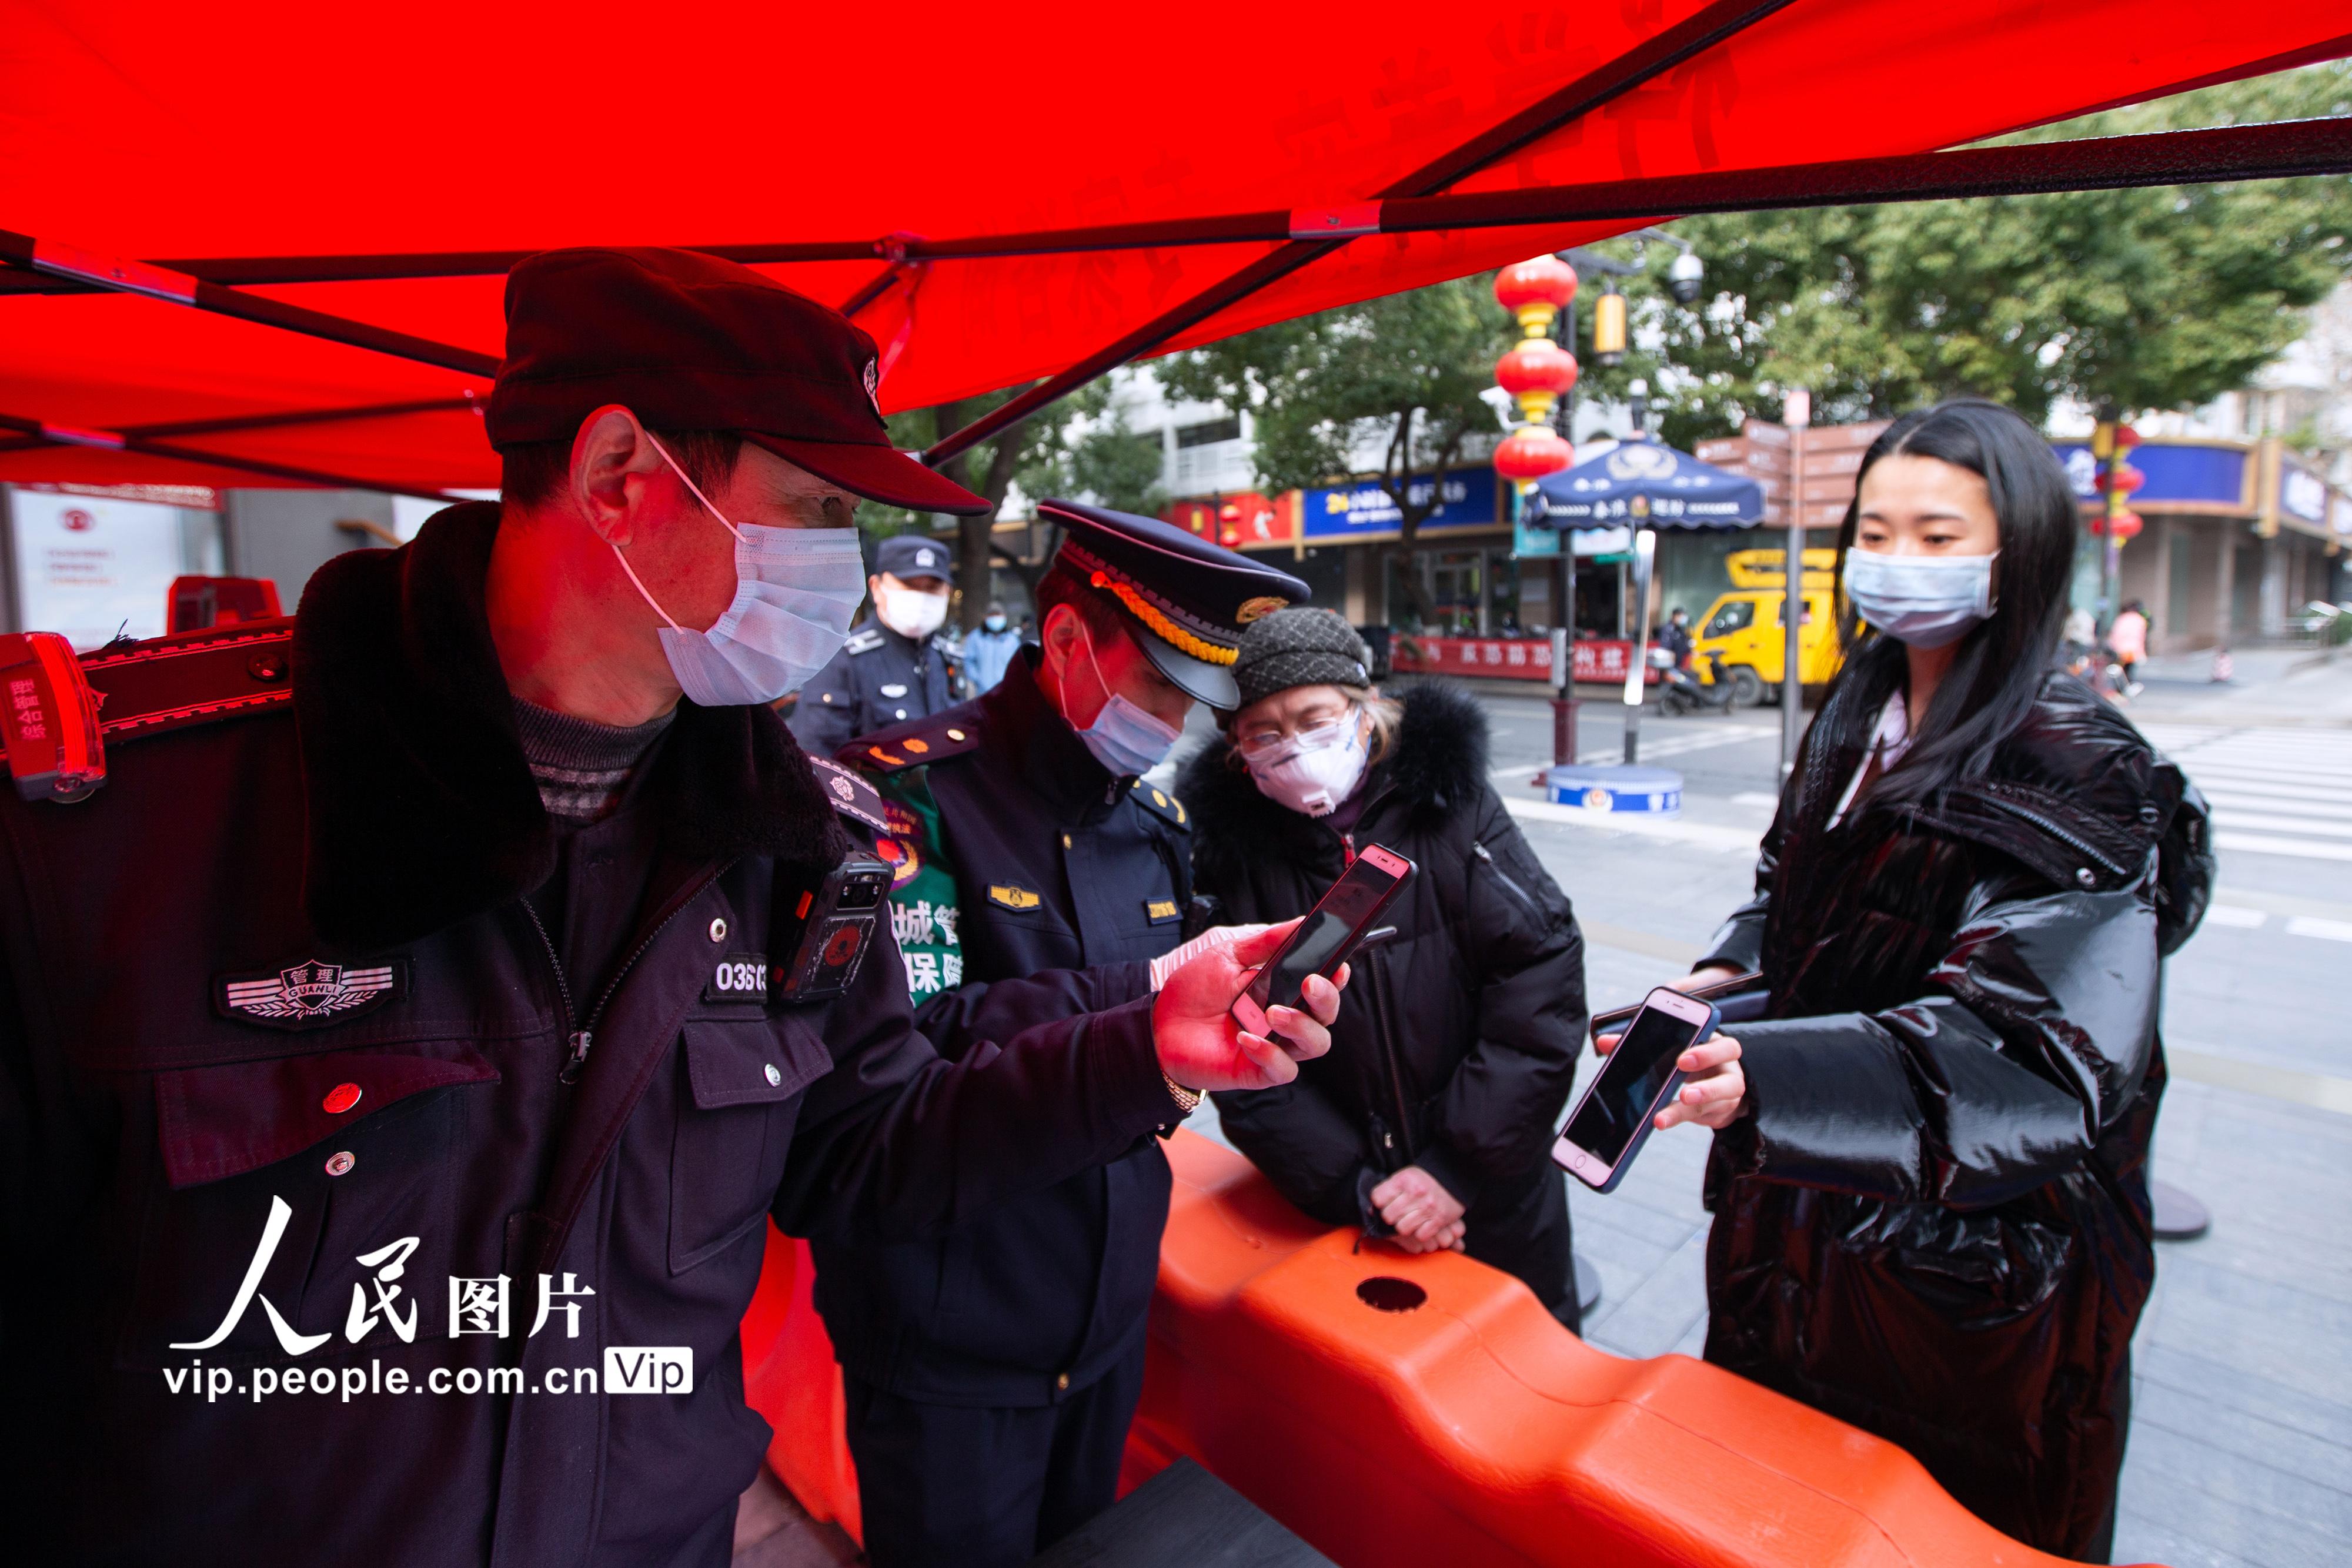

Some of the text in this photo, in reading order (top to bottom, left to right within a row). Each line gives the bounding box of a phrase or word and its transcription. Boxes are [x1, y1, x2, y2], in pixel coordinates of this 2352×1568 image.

[10, 678, 46, 739] 综合管理
[290, 969, 333, 985] 管理
[289, 985, 336, 997] GUANLI
